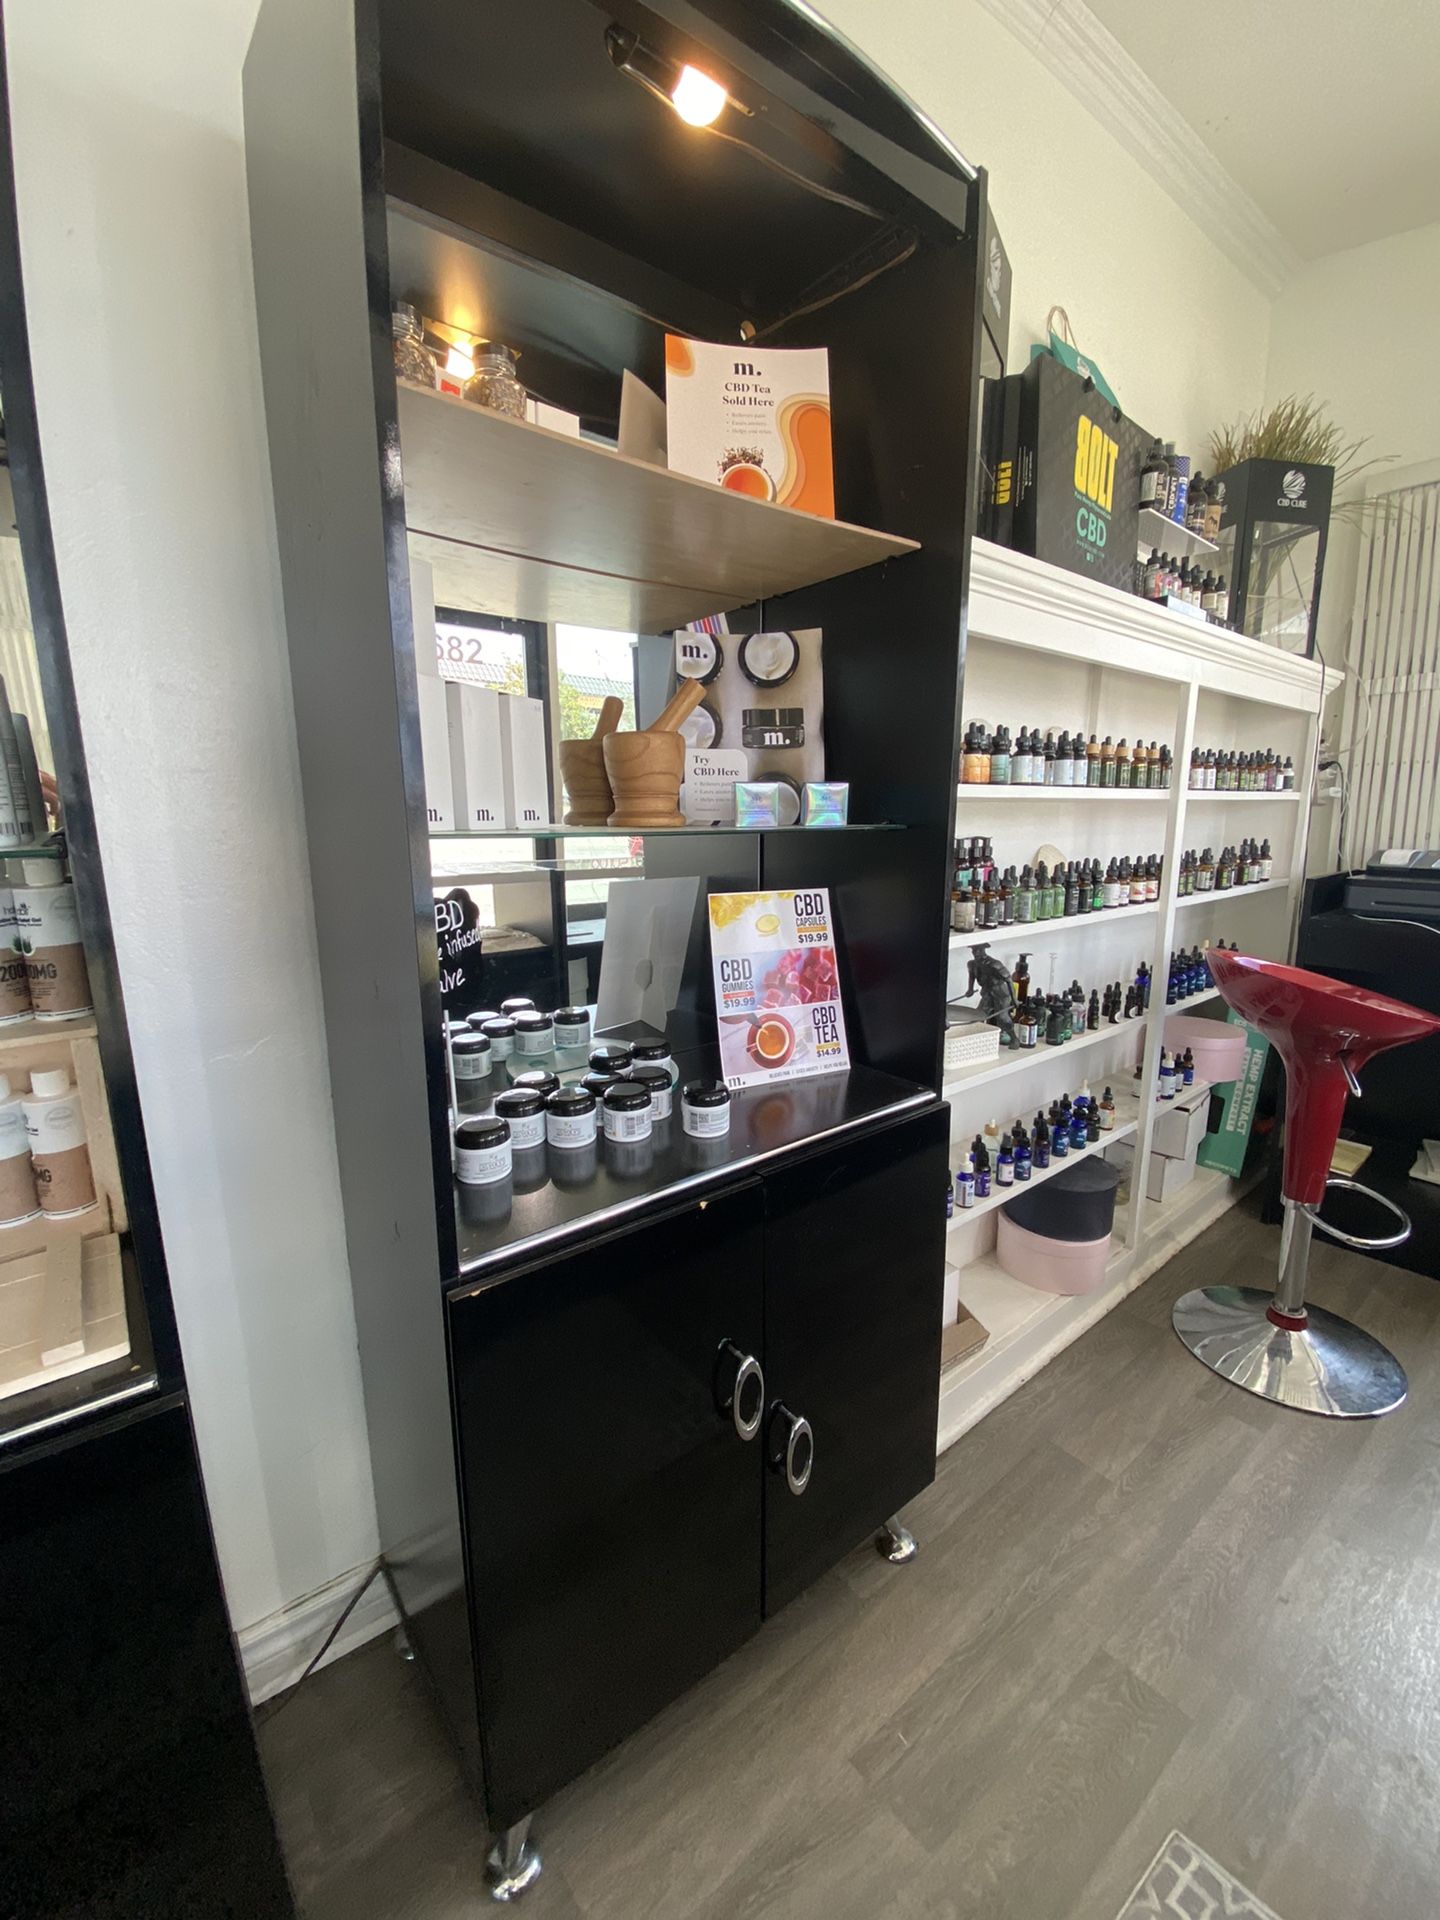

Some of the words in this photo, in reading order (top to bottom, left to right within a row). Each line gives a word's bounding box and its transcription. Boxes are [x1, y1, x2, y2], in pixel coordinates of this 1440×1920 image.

[733, 362, 762, 376] m.
[724, 382, 750, 393] CBD
[752, 383, 771, 394] Tea
[722, 395, 746, 406] Sold
[749, 396, 774, 407] Here
[1077, 507, 1106, 548] CBD
[682, 644, 708, 659] m.
[763, 731, 791, 746] m.
[693, 755, 710, 766] Try
[693, 767, 715, 777] CBD
[717, 767, 740, 777] Here
[477, 808, 494, 822] m.
[524, 808, 540, 822] m.
[794, 893, 824, 917] CBD
[434, 900, 464, 932] BD
[796, 916, 827, 927] CAPSULES
[445, 928, 481, 959] infused
[798, 932, 828, 944] $19.99
[720, 958, 752, 983] CBD
[722, 980, 754, 993] GUMMIES
[723, 997, 756, 1009] $19.99
[812, 1005, 837, 1026] CBD
[814, 1023, 840, 1044] TEA
[816, 1046, 842, 1058] $14.99
[1250, 1048, 1264, 1083] HEMP
[728, 1076, 746, 1088] m.
[1236, 1084, 1256, 1136] EXTRACT
